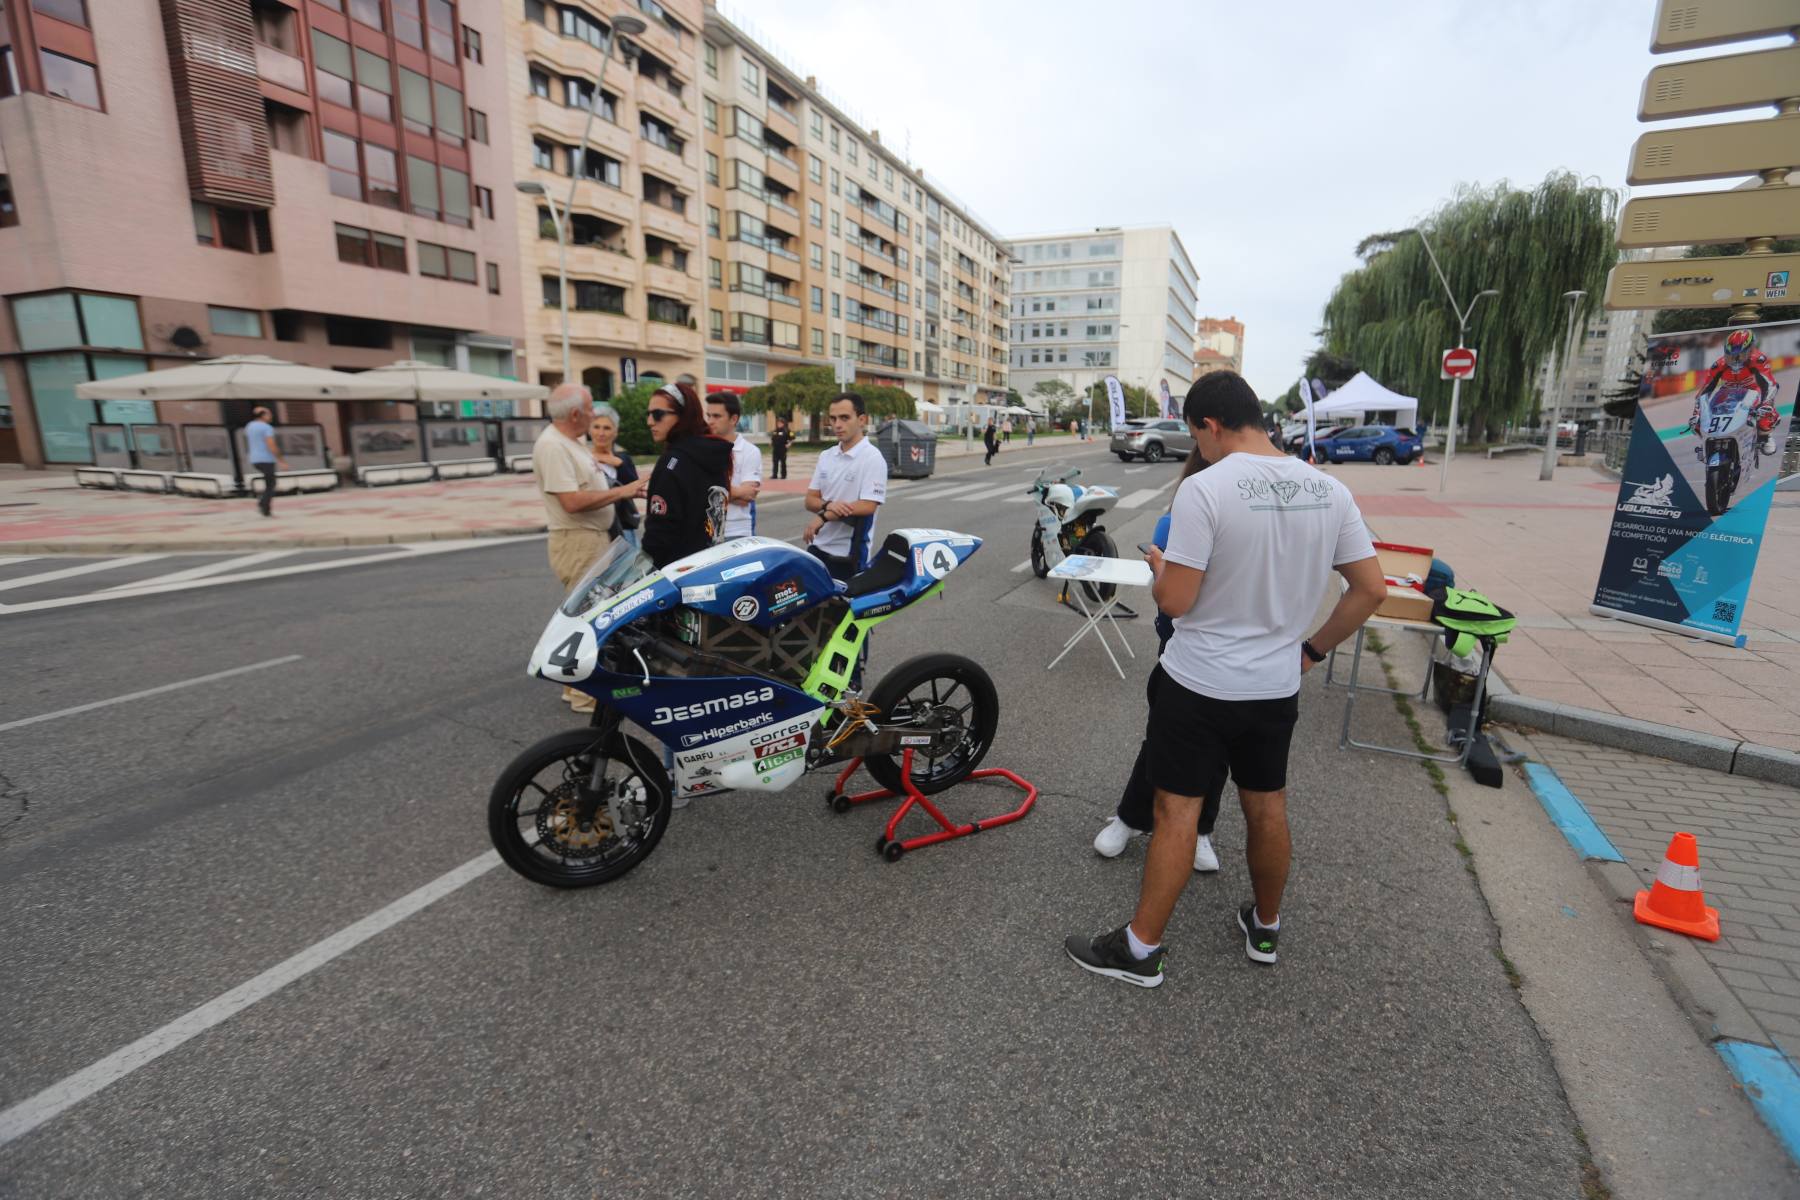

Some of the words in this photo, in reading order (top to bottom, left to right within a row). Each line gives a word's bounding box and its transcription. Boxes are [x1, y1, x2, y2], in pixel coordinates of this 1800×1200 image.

[1708, 416, 1733, 434] 97
[1617, 503, 1682, 519] UBURacing
[1611, 529, 1621, 537] DE
[1621, 531, 1668, 544] COMPETICIÓN
[1613, 521, 1656, 533] DESARROLLO
[1656, 526, 1667, 534] DE
[1668, 527, 1684, 537] UNA
[1685, 530, 1708, 540] MOTO
[1709, 533, 1754, 545] ELÉCTRICA
[932, 550, 951, 572] 4
[548, 631, 585, 676] 4
[702, 712, 773, 741] Hiperbaric
[750, 720, 810, 746] correa
